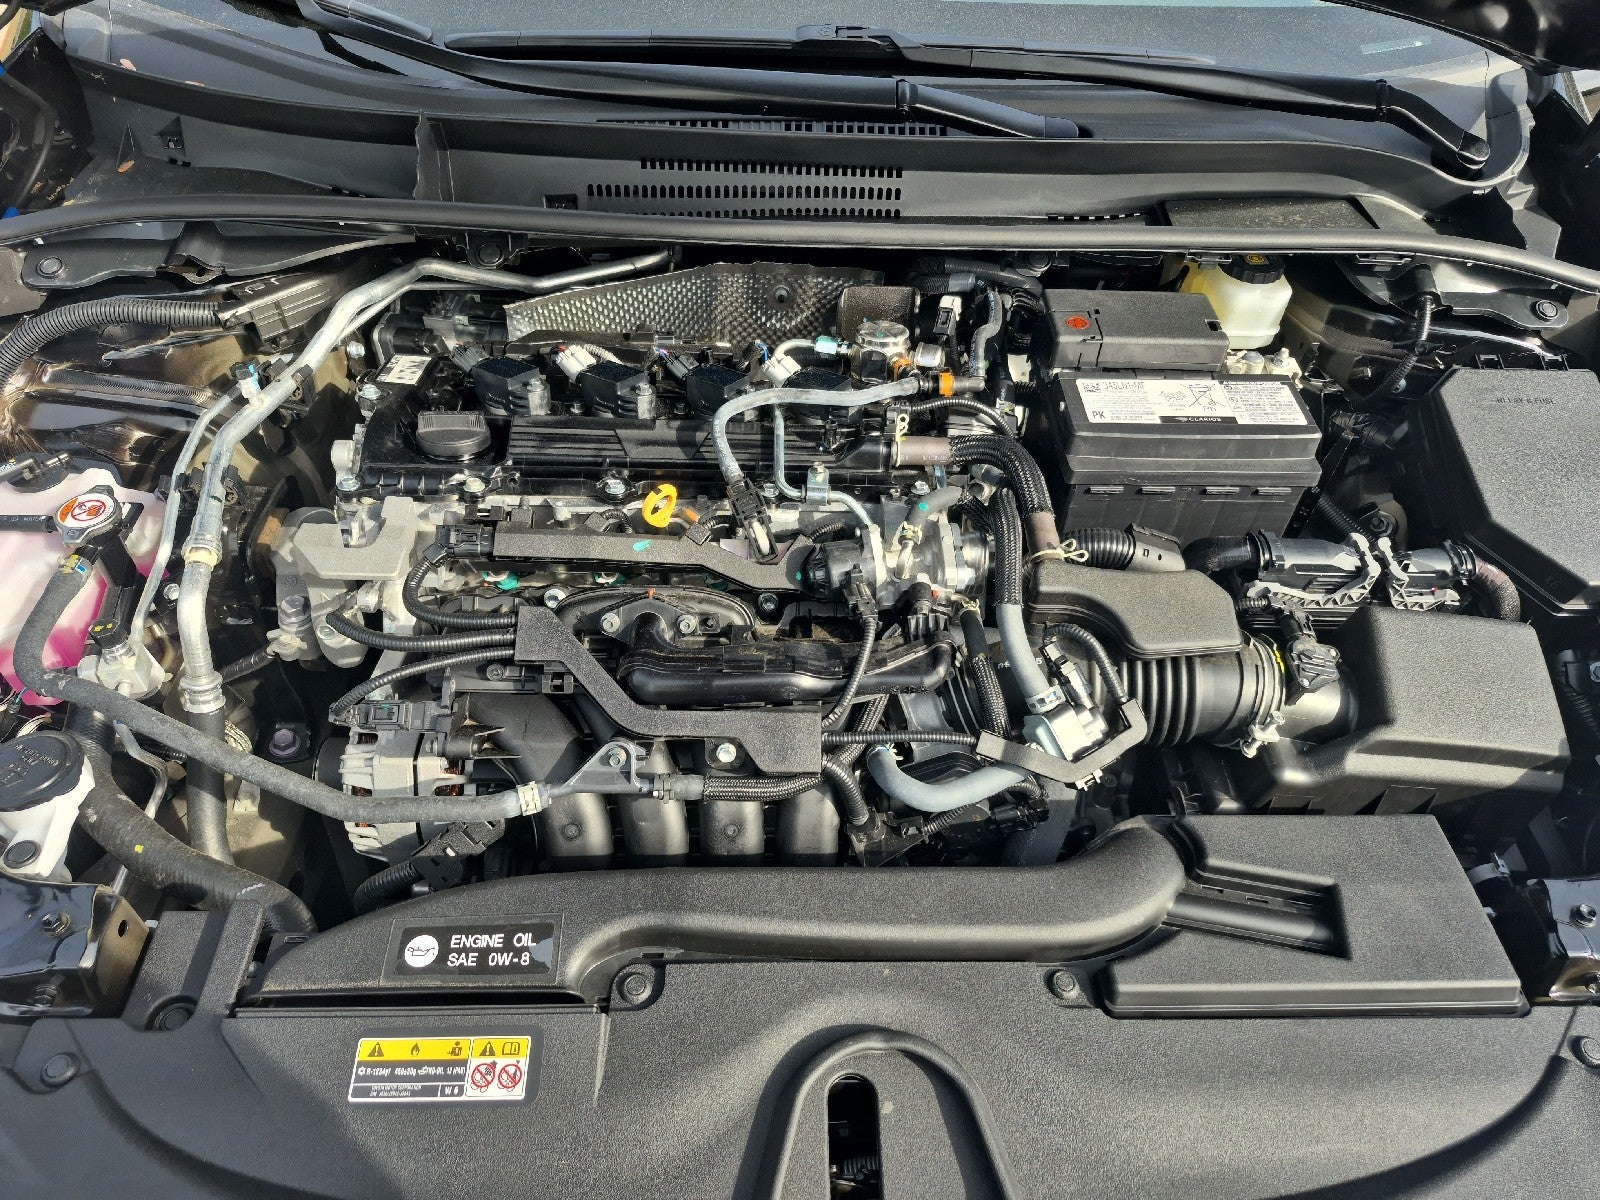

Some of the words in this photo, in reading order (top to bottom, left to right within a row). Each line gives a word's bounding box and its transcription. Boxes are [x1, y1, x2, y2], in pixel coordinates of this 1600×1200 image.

[1091, 410, 1106, 419] PK
[450, 934, 505, 948] ENGINE
[513, 932, 537, 948] OIL
[447, 952, 479, 967] SAE
[488, 951, 530, 966] 0W-8
